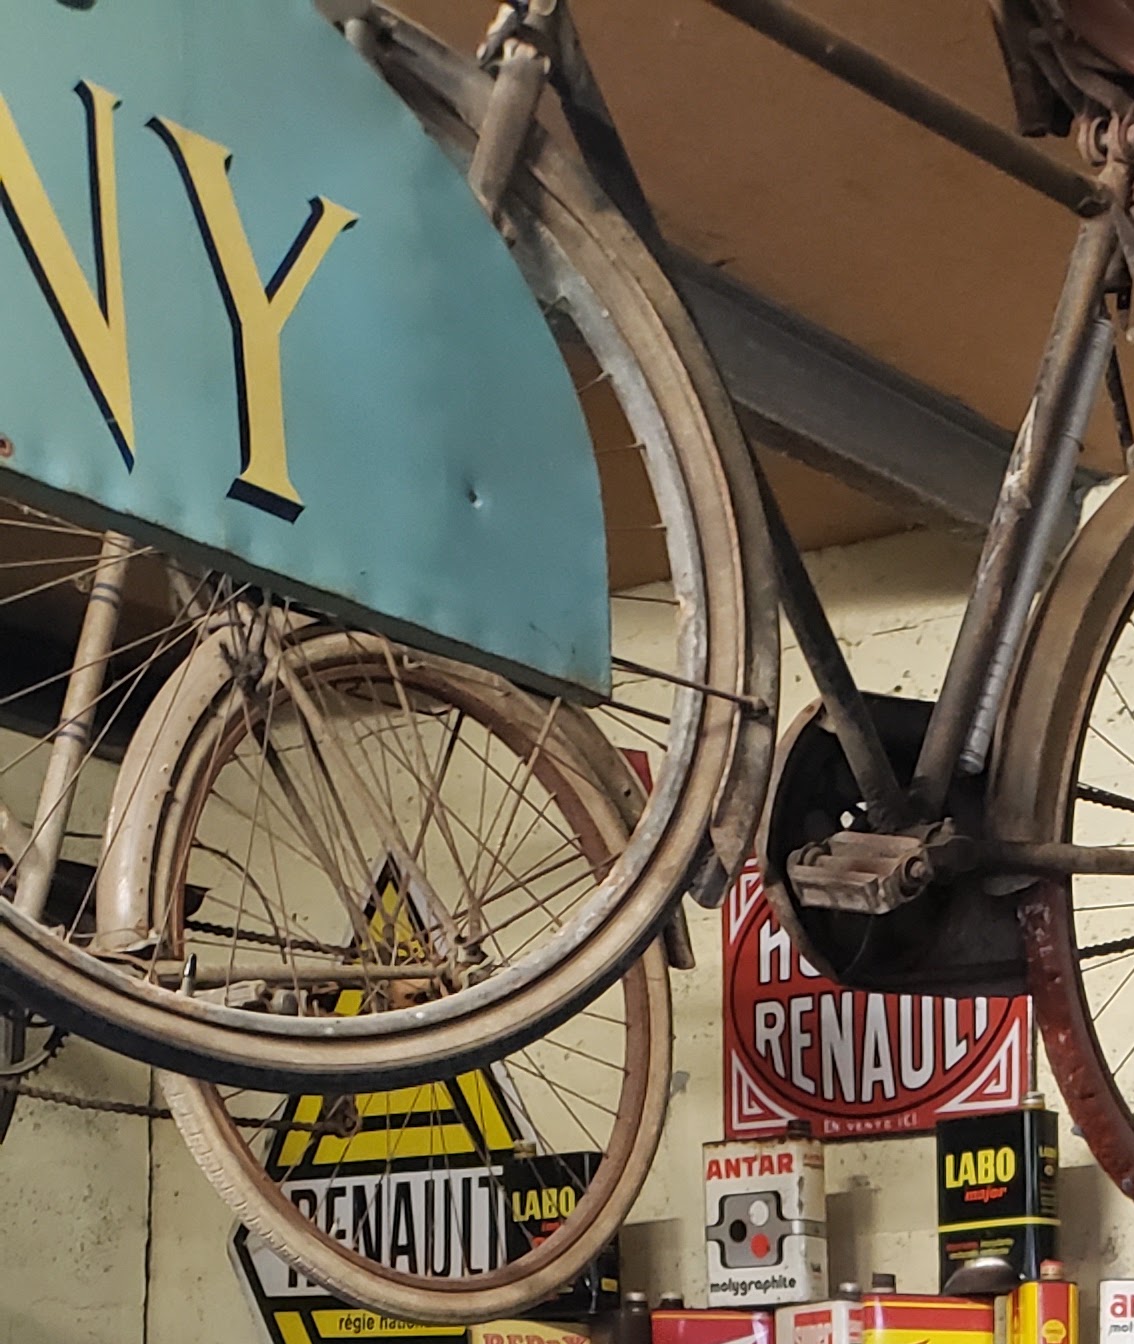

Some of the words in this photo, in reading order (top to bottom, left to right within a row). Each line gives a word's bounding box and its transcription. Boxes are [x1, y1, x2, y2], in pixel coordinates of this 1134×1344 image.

[706, 1152, 794, 1182] ANTAR
[945, 1146, 1016, 1189] LABO
[512, 1185, 576, 1223] LABO
[964, 1186, 1008, 1203] major
[709, 1275, 798, 1296] molygraphite
[338, 1313, 376, 1334] régie
